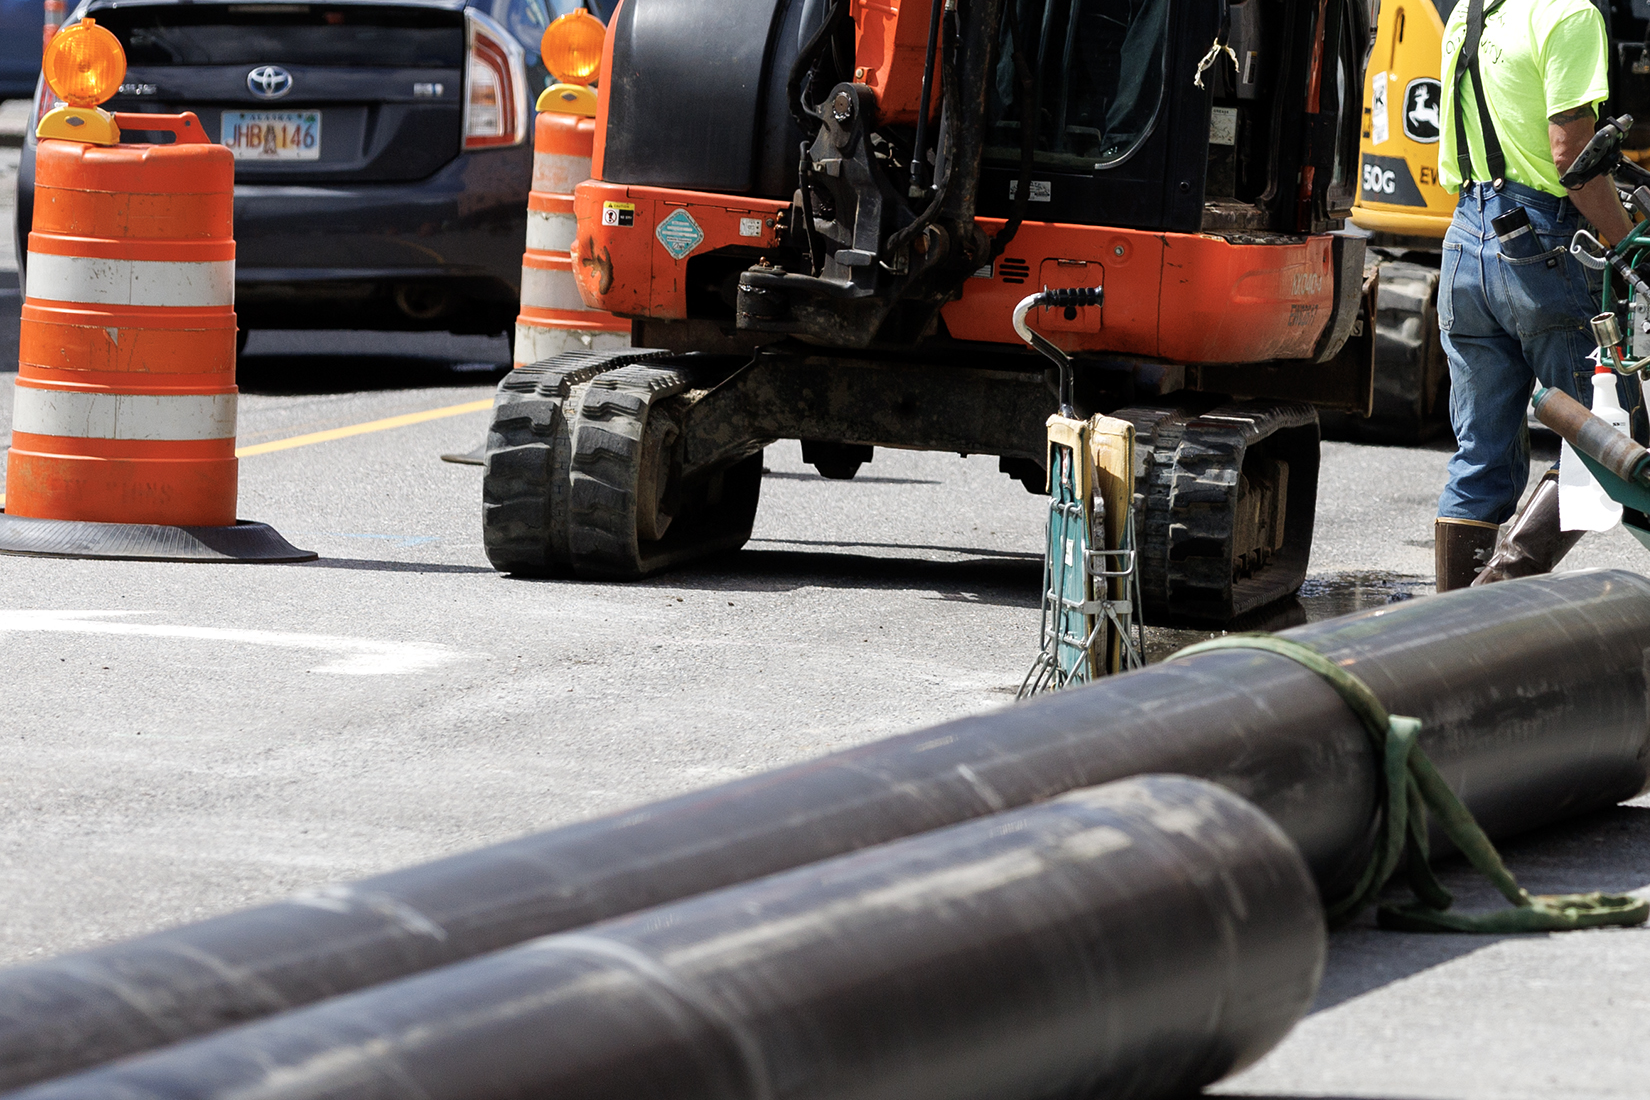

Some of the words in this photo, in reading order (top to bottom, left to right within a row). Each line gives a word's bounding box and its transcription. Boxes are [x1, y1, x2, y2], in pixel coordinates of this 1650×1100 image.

[224, 123, 262, 149] JHB
[281, 123, 316, 149] 146
[1363, 163, 1396, 194] 50G
